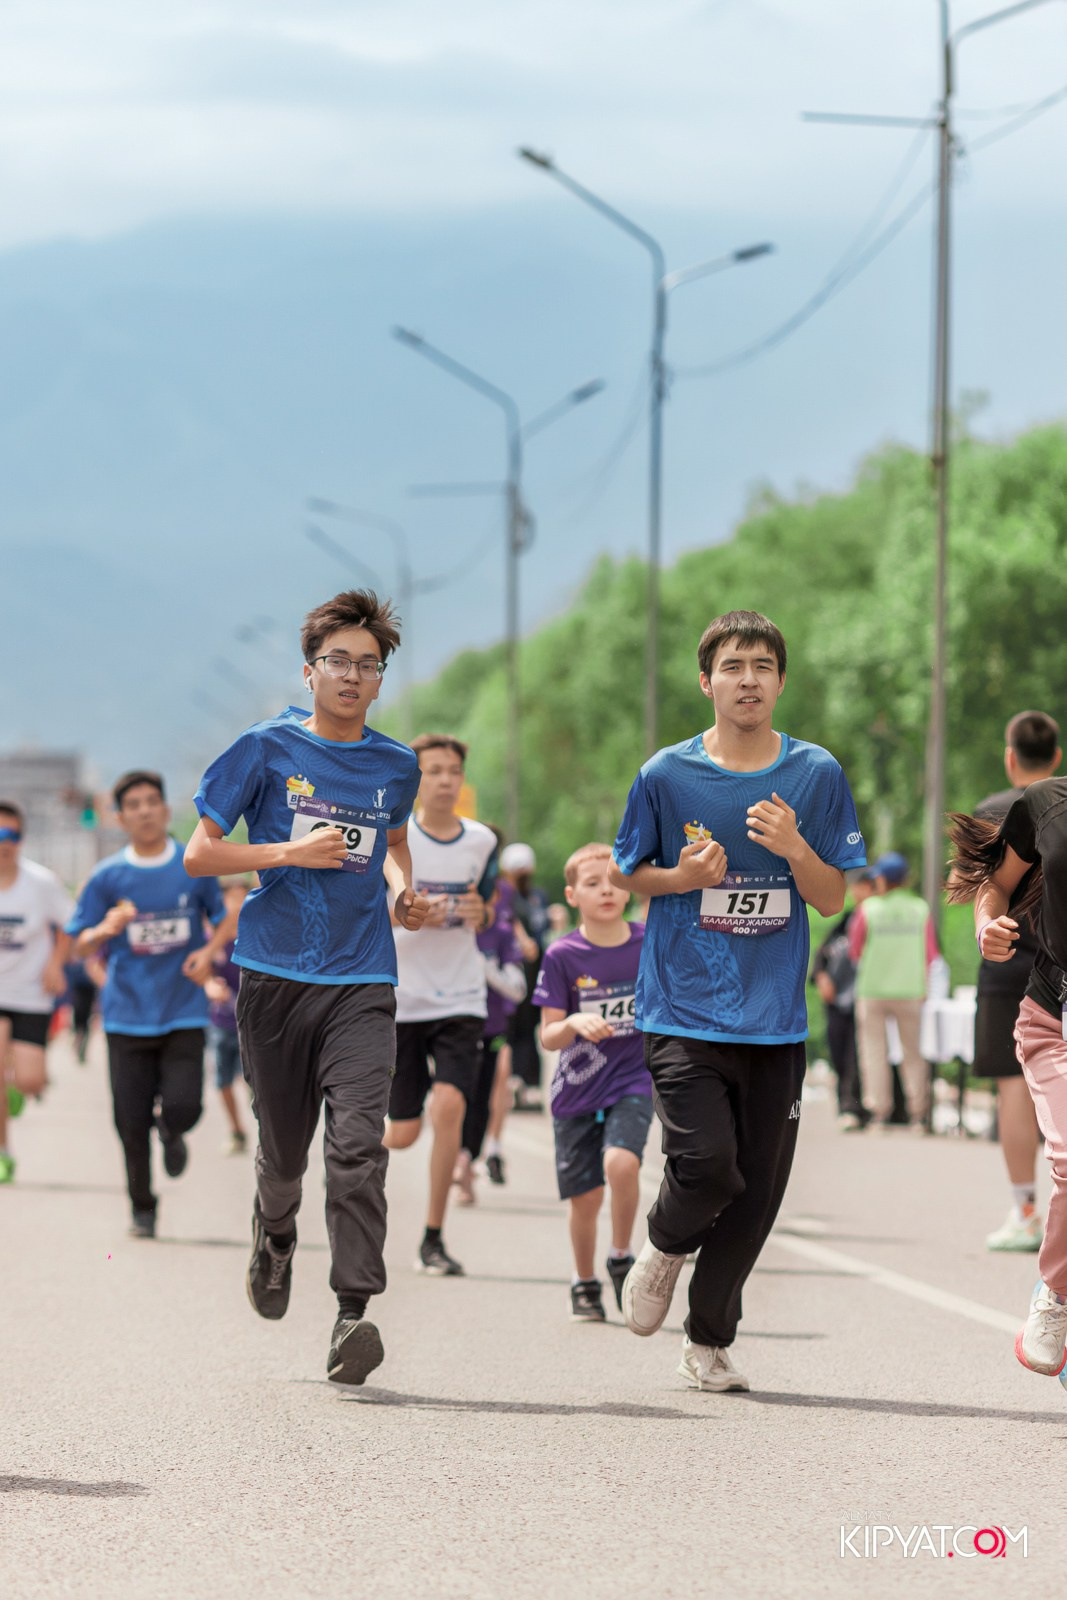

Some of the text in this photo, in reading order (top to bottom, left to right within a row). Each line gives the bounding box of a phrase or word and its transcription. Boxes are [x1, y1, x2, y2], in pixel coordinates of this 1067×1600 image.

[727, 892, 769, 915] 151
[702, 916, 786, 926] БАЛАЛАР ЖАРЫСЫ
